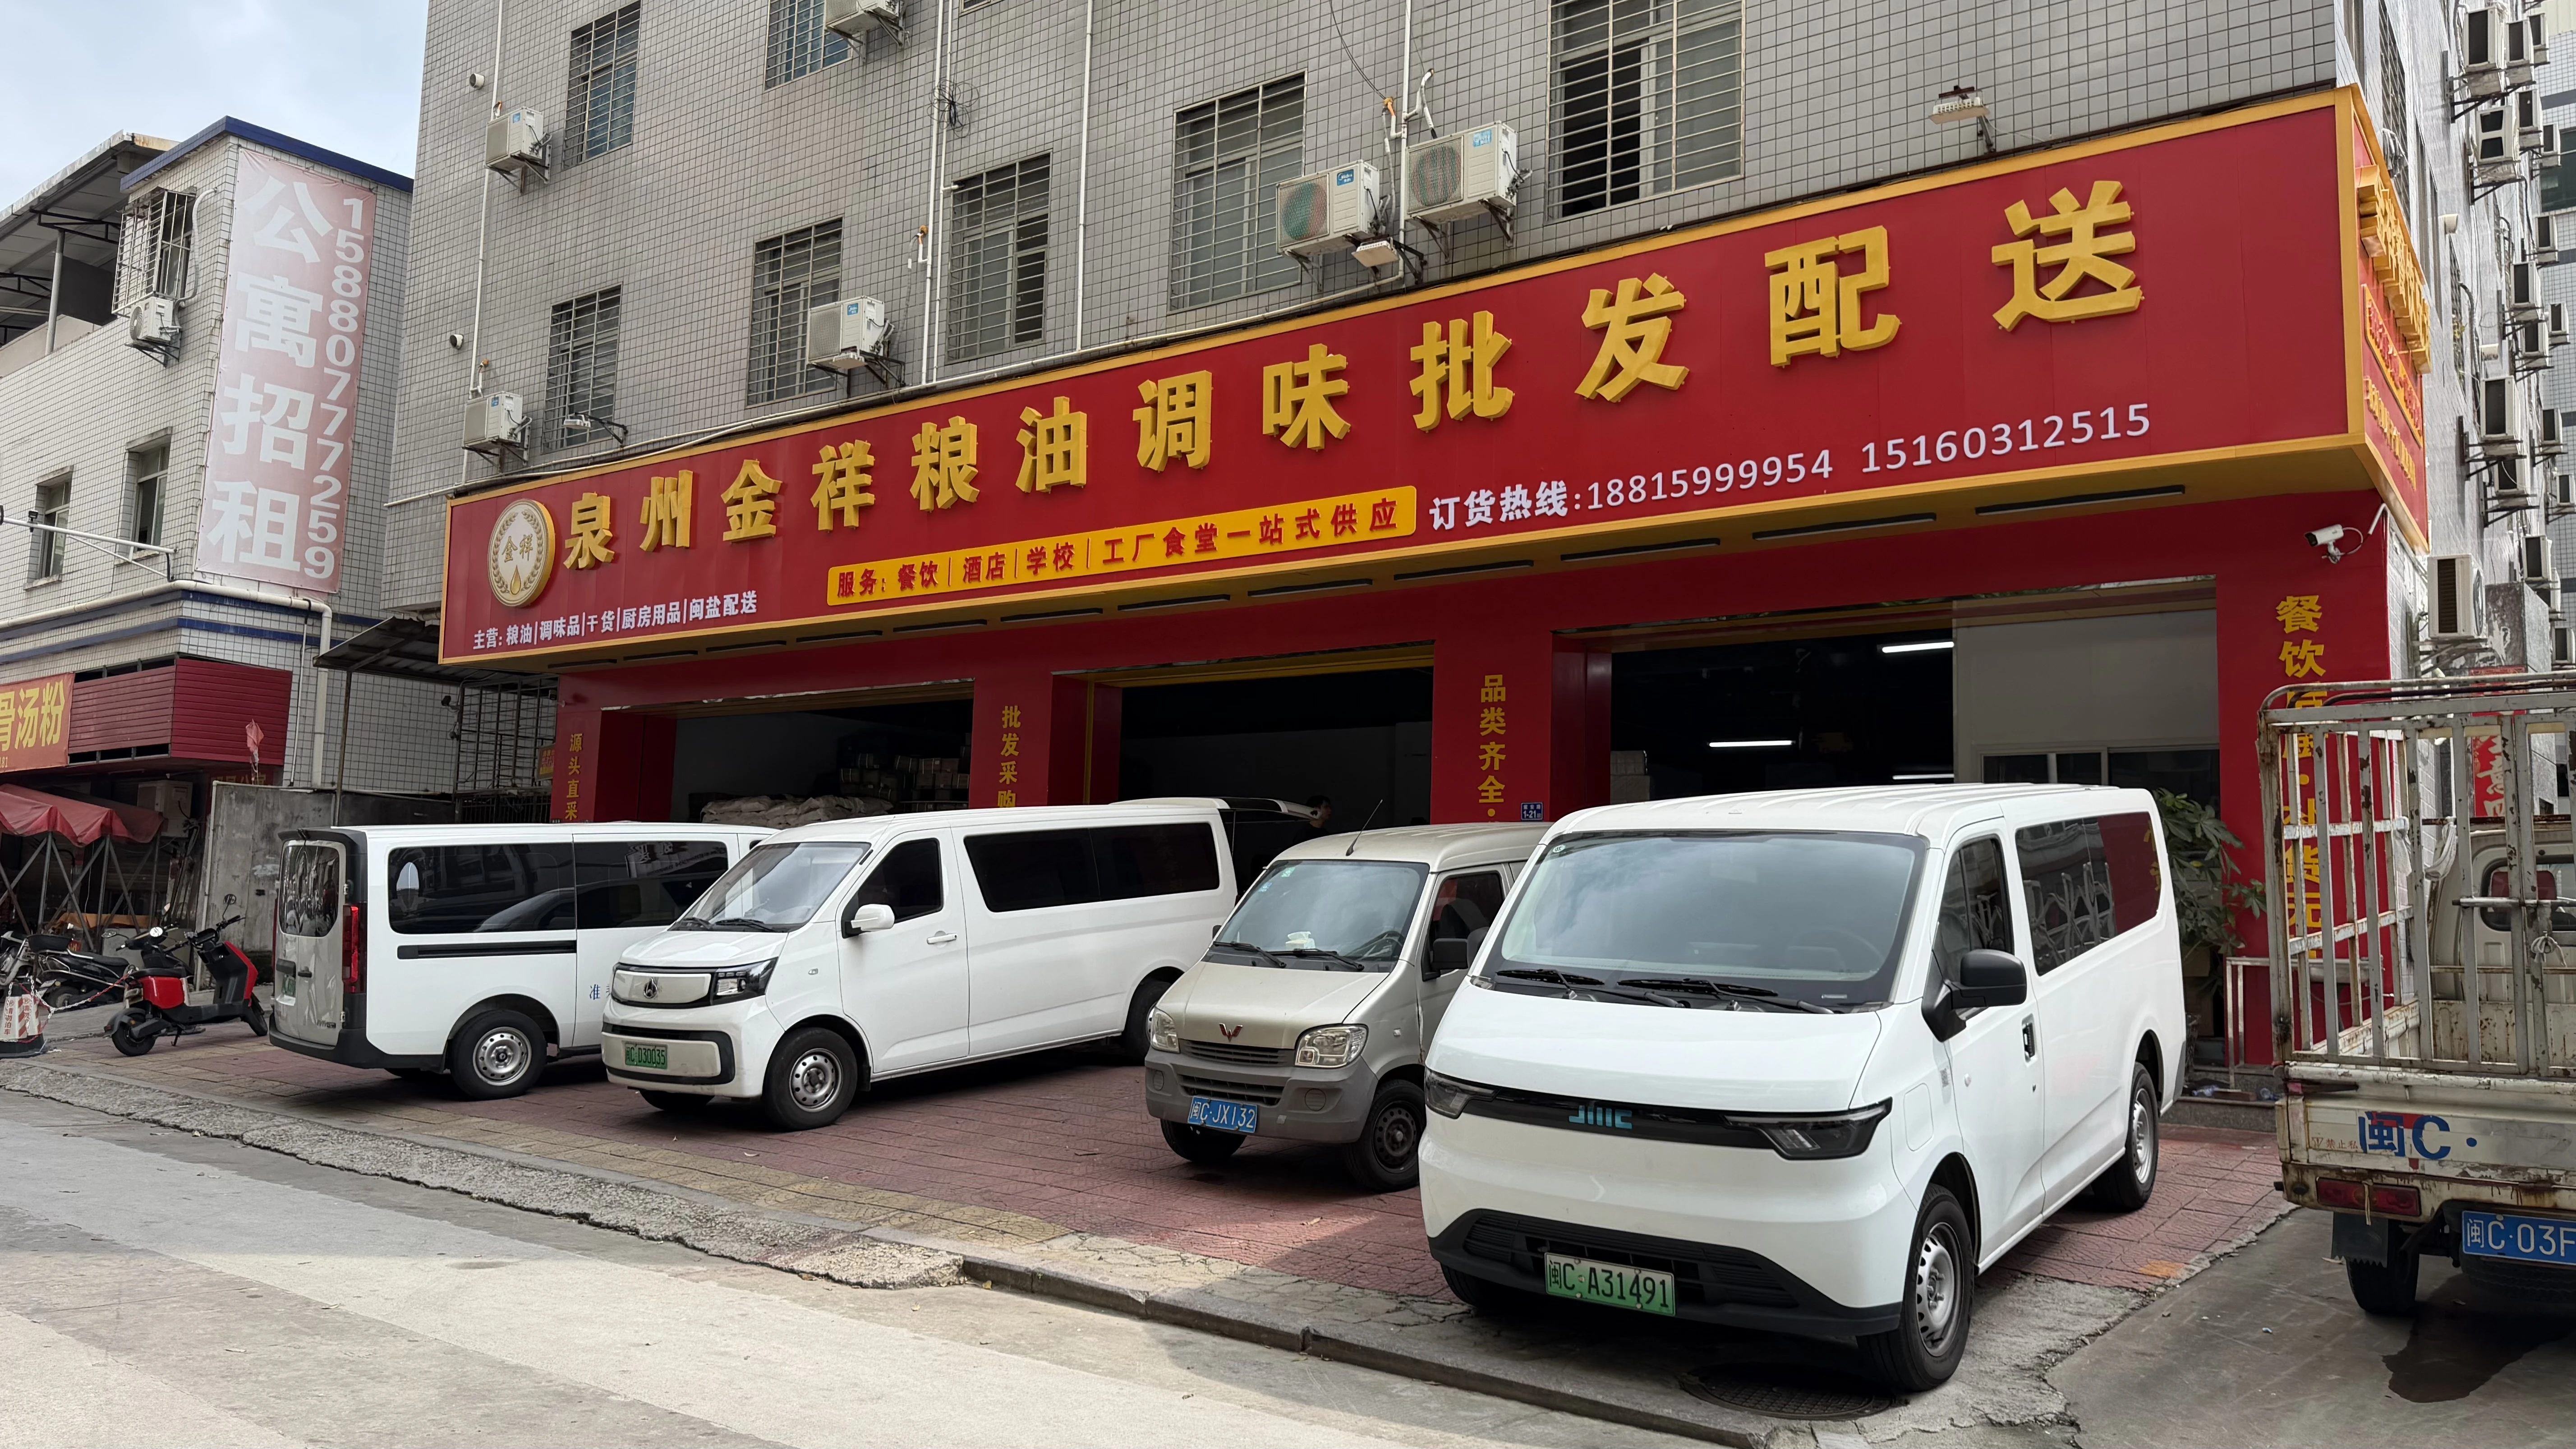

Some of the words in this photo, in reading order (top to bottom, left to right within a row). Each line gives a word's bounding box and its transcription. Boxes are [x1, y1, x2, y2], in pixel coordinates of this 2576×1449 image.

[207, 175, 333, 571] 公寓招租
[304, 198, 364, 579] 15880777259
[563, 179, 2144, 570] 泉州金祥粮油调味批发配送
[1861, 403, 2150, 474] 15160312515
[501, 534, 533, 562] 金祥
[0, 679, 65, 751] 骨汤粉
[998, 705, 1021, 808] 批发采购
[565, 732, 583, 820] 源头直采
